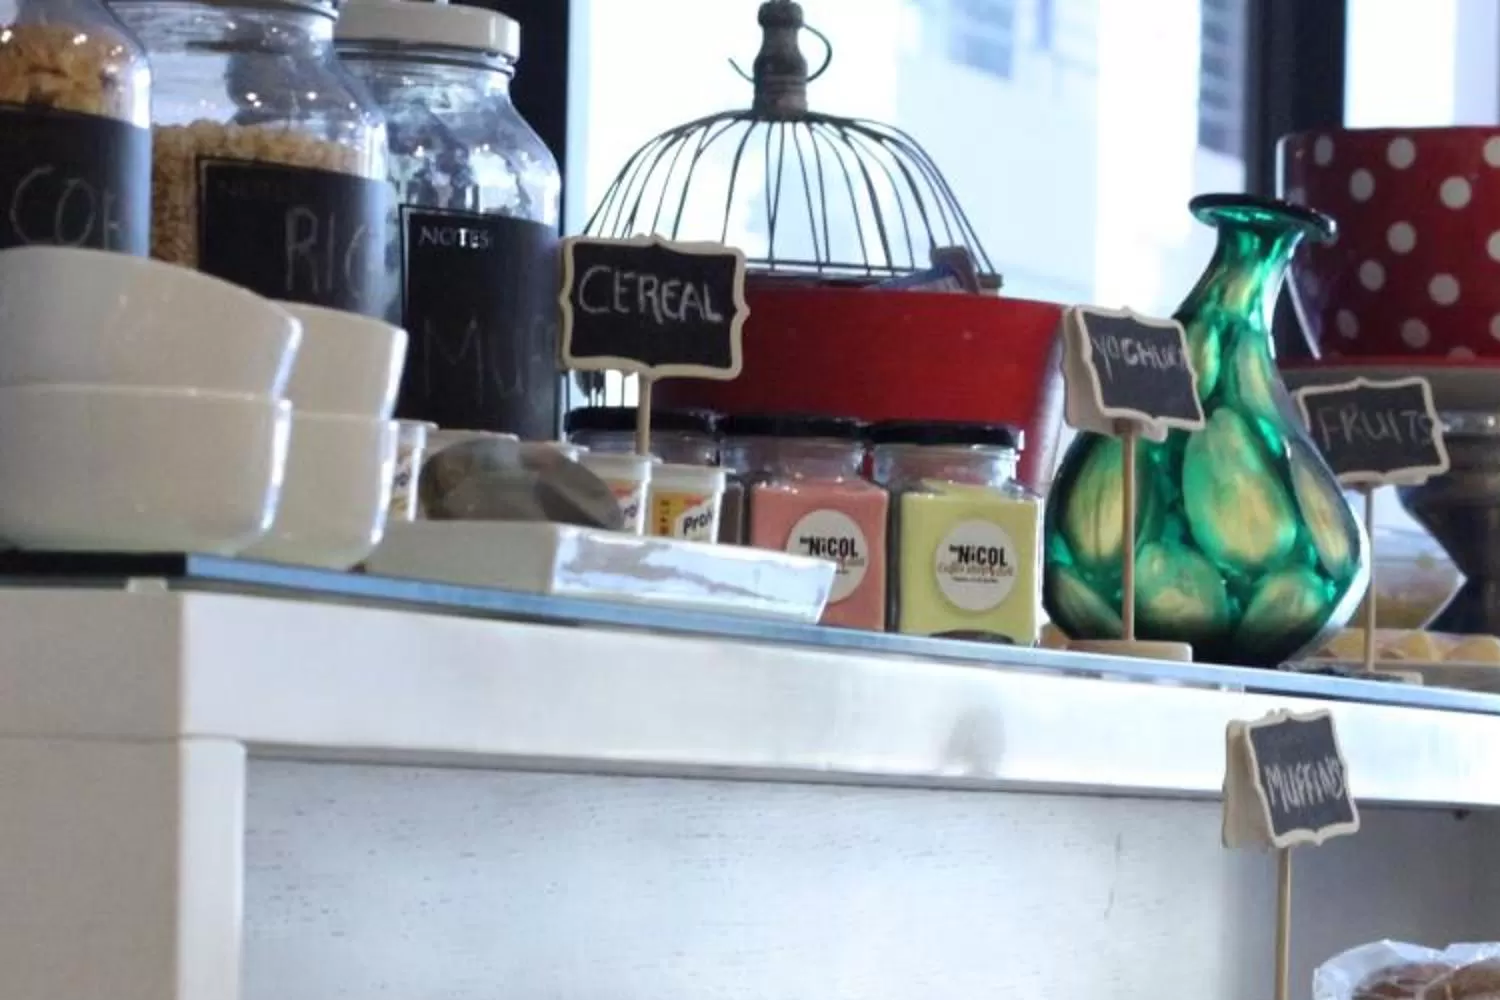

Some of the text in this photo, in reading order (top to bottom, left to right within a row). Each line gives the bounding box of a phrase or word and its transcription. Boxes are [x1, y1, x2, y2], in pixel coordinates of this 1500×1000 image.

[418, 226, 490, 248] NOTES
[579, 264, 724, 325] CEREAL
[1263, 753, 1344, 814] MUFFINS
